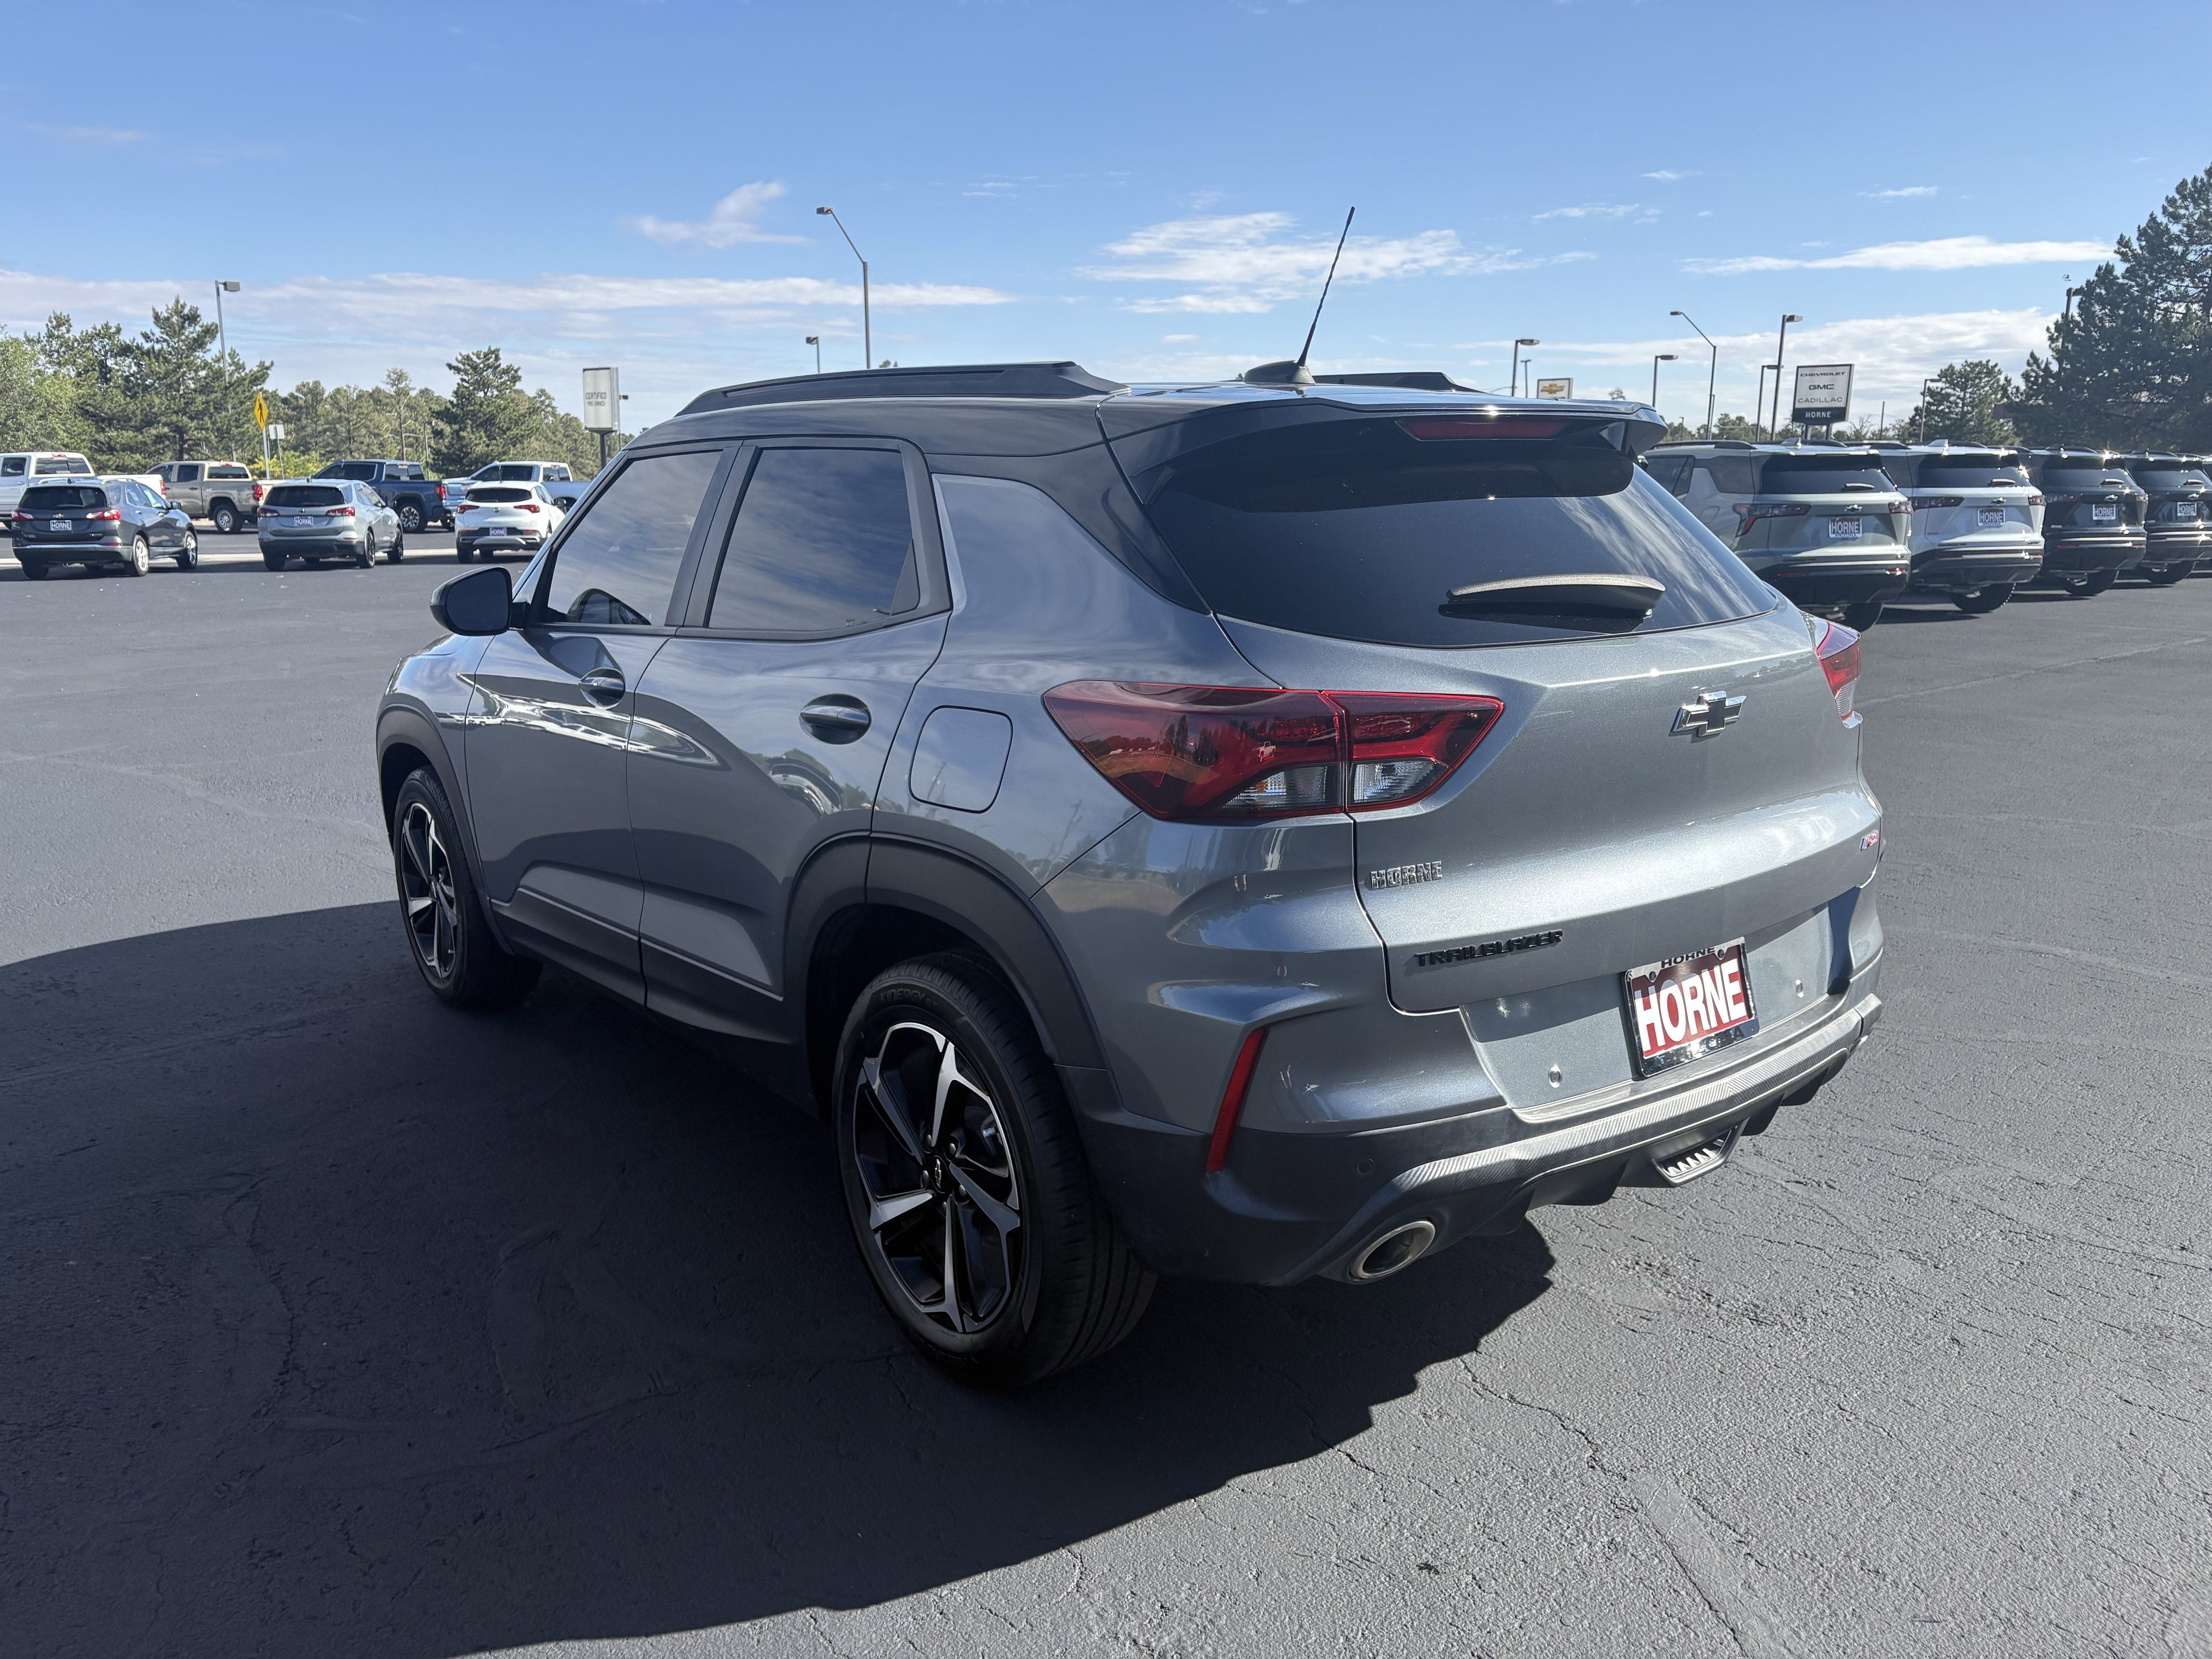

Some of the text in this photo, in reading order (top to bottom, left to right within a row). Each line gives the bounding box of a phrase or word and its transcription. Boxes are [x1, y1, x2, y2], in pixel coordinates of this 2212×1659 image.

[1980, 512, 2003, 523] HORNE
[2094, 507, 2114, 516] HORNE
[1831, 521, 1859, 533] HORNE
[1371, 861, 1443, 890] HORNE
[1415, 929, 1563, 966] TRAILBLAZER
[1661, 947, 1716, 968] HORNE
[1634, 958, 1747, 1052] HORNE
